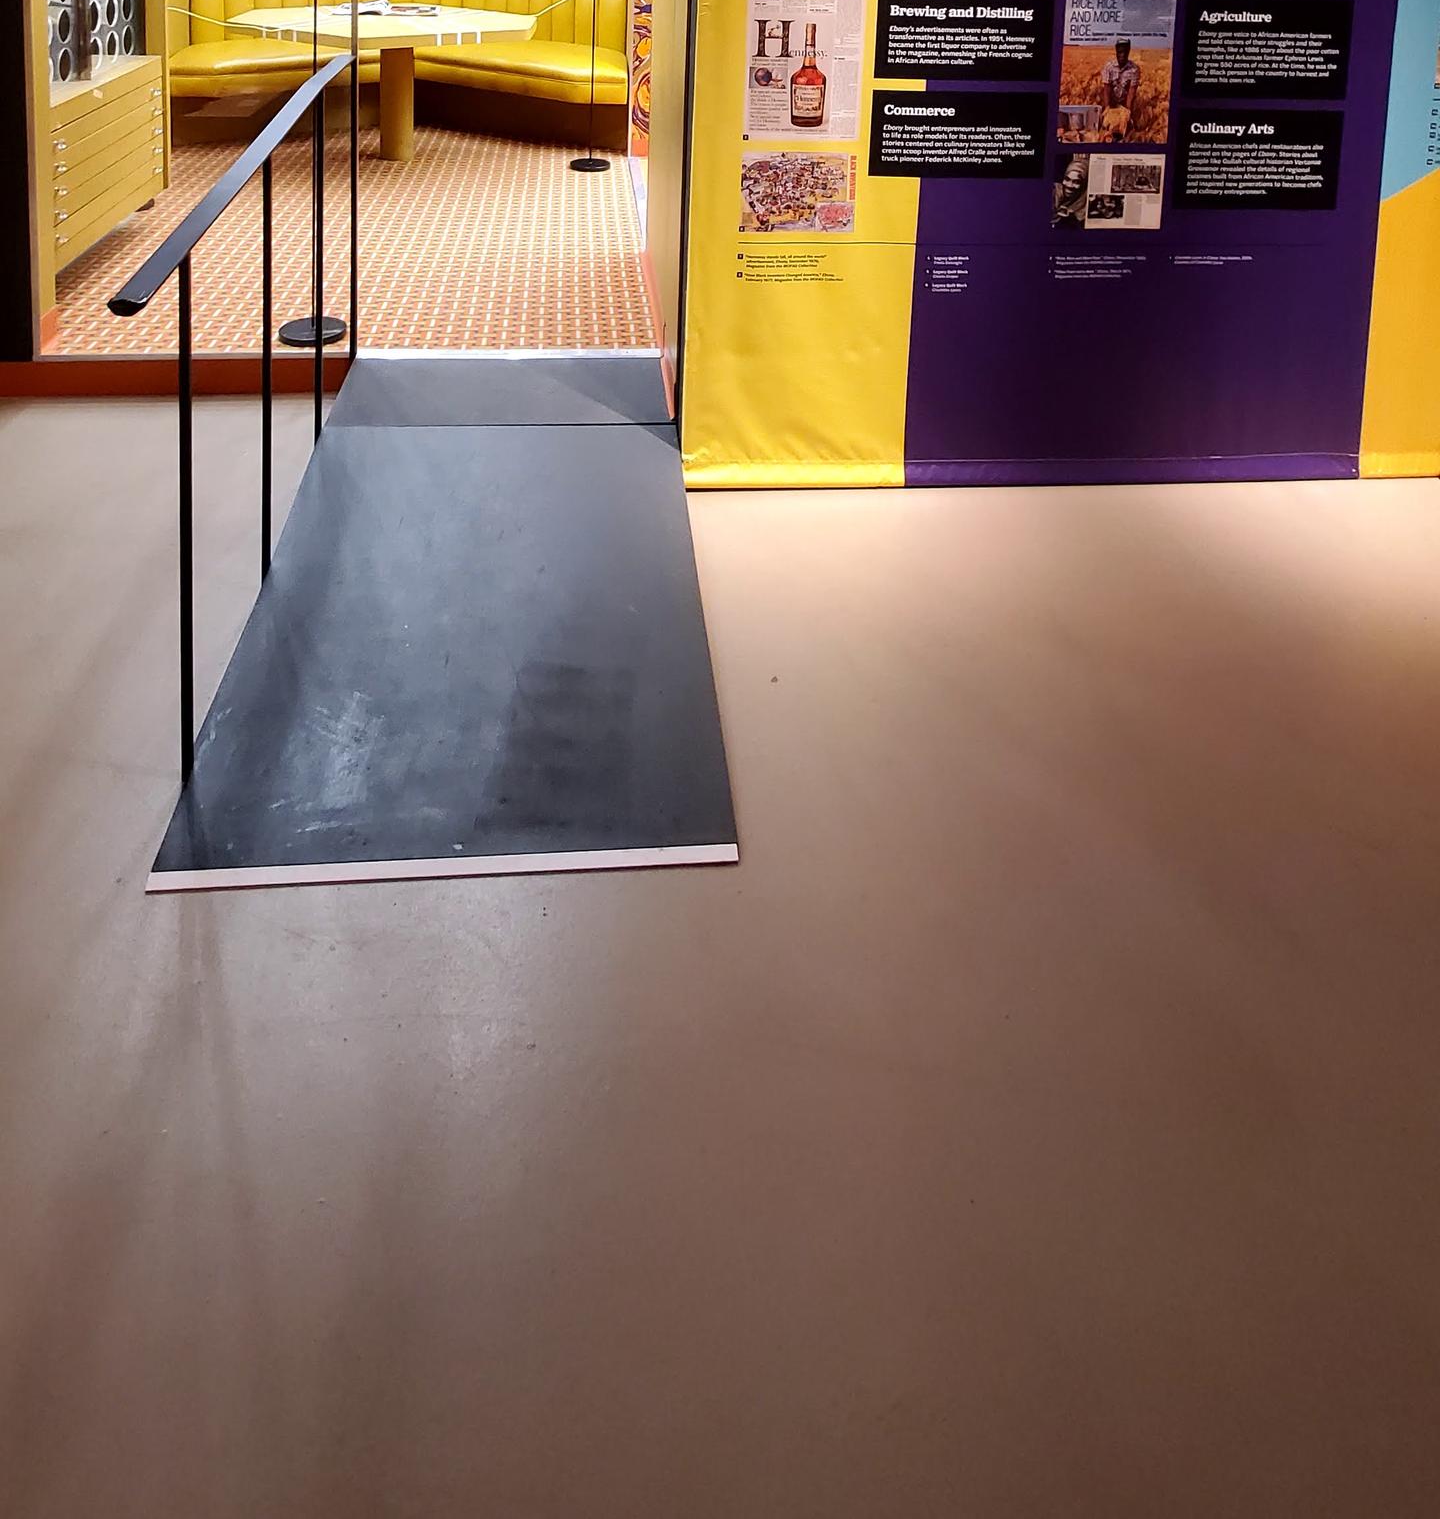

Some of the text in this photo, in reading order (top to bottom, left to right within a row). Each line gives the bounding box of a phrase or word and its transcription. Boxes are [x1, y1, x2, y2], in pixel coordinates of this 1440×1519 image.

[890, 5, 1033, 22] Brewing and Distilling
[1070, 11, 1121, 23] AND MORE
[1200, 10, 1272, 24] Agriculture
[1070, 24, 1091, 36] RICE
[941, 42, 960, 50] liquor
[884, 104, 955, 116] Commerce
[1191, 122, 1274, 136] Culinary Arts
